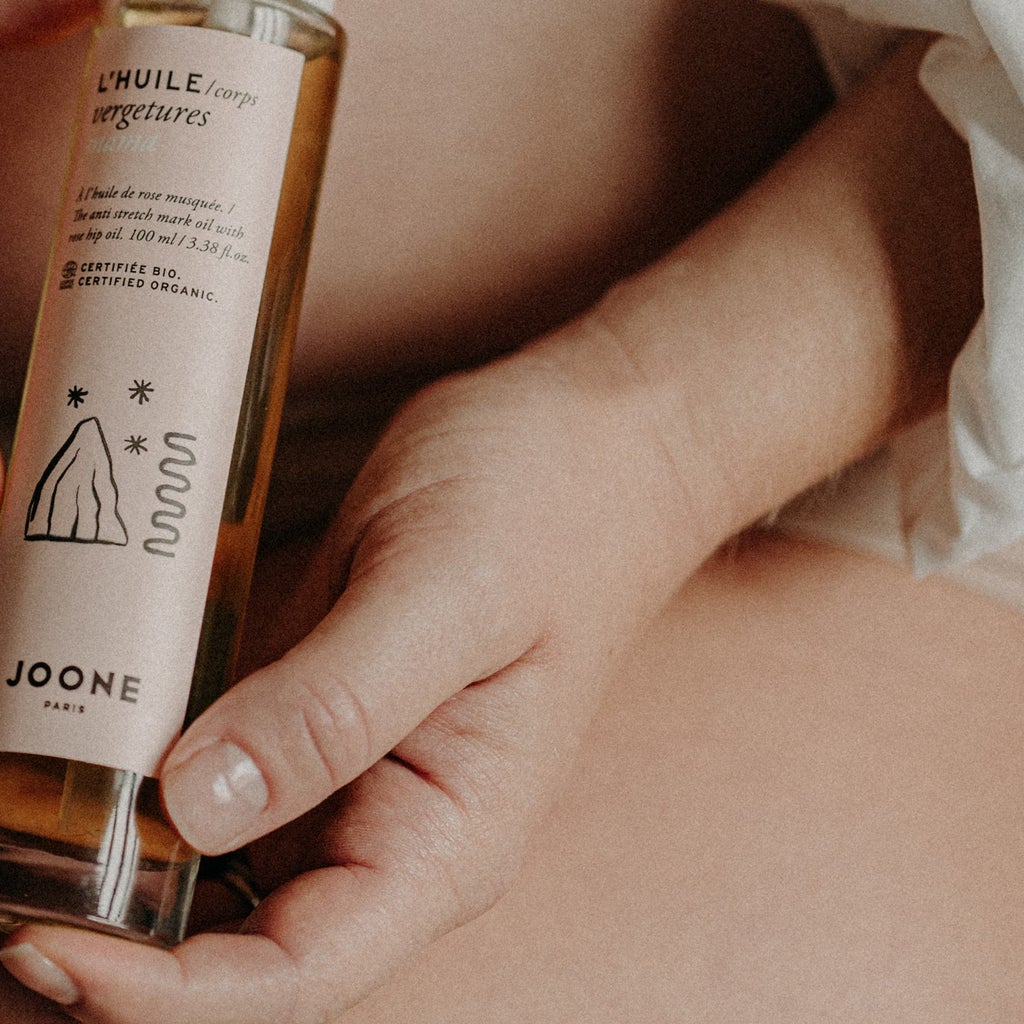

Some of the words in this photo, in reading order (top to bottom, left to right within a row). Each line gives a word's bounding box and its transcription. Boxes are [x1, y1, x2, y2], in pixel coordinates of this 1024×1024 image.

[97, 69, 203, 93] L'HUILE
[92, 101, 211, 130] vergetures
[84, 185, 118, 201] l'huile
[120, 186, 135, 199] de
[138, 191, 162, 201] rose
[165, 193, 224, 213] musquée.
[73, 209, 88, 223] The
[89, 207, 112, 221] anti
[112, 208, 153, 221] stretch
[156, 212, 192, 227] mark
[195, 219, 214, 232] oil
[216, 222, 245, 240] with
[85, 227, 103, 245] hip
[105, 226, 123, 240] oil.
[129, 228, 156, 242] 100
[157, 232, 177, 245] ml
[186, 236, 219, 254] 3.38
[80, 261, 147, 275] CERTIFIÉE
[152, 266, 181, 280] BIO.
[78, 276, 145, 288] CERTIFIED
[150, 280, 219, 304] ORGANIC.
[6, 660, 141, 704] JOONE
[44, 700, 85, 714] PARIS
